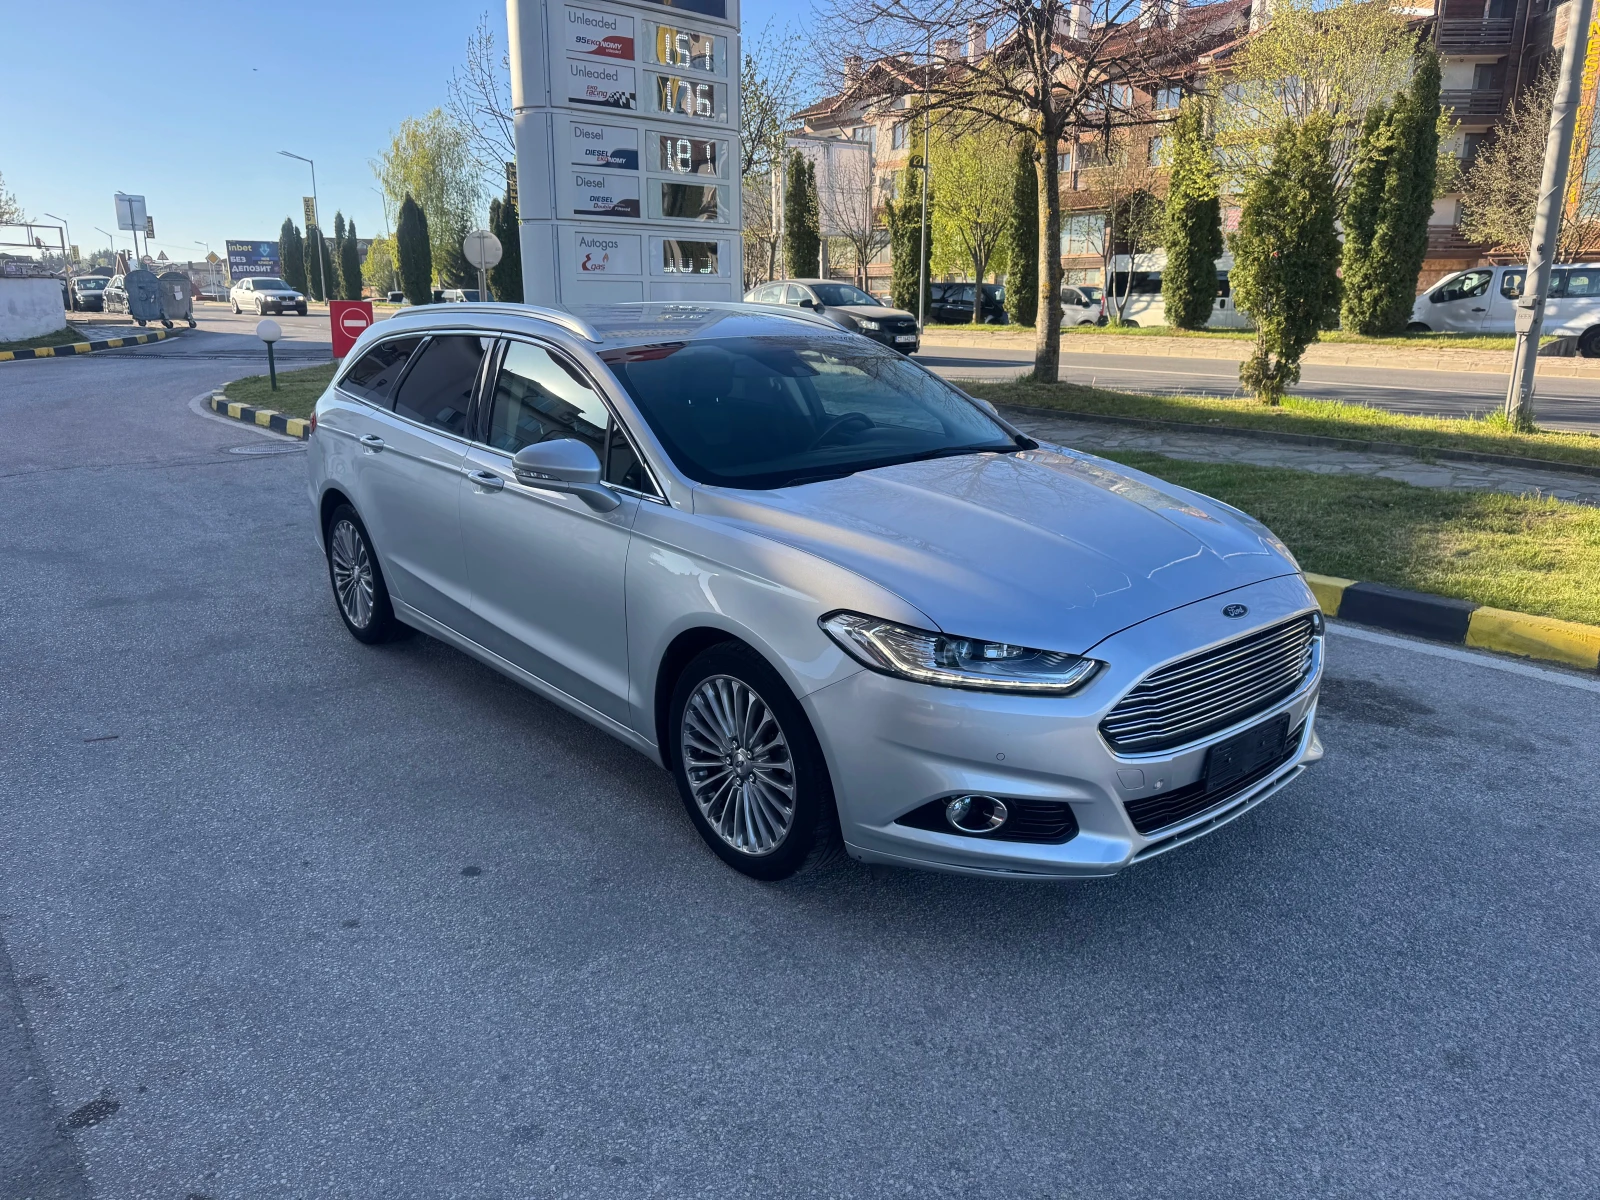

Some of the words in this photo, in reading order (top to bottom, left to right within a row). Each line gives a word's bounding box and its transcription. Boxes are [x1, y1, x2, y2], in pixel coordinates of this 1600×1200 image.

[568, 11, 617, 31] Unleaded
[570, 64, 618, 82] Unleaded
[585, 90, 608, 99] racing
[574, 126, 604, 141] Diesel
[585, 148, 609, 157] DIESEL
[575, 175, 605, 189] Diesel
[589, 195, 613, 203] DIESEL
[228, 243, 253, 252] inbet
[579, 236, 619, 251] Autogas
[231, 264, 272, 272] ДЕПОЗИТ
[1227, 605, 1245, 617] Ford
